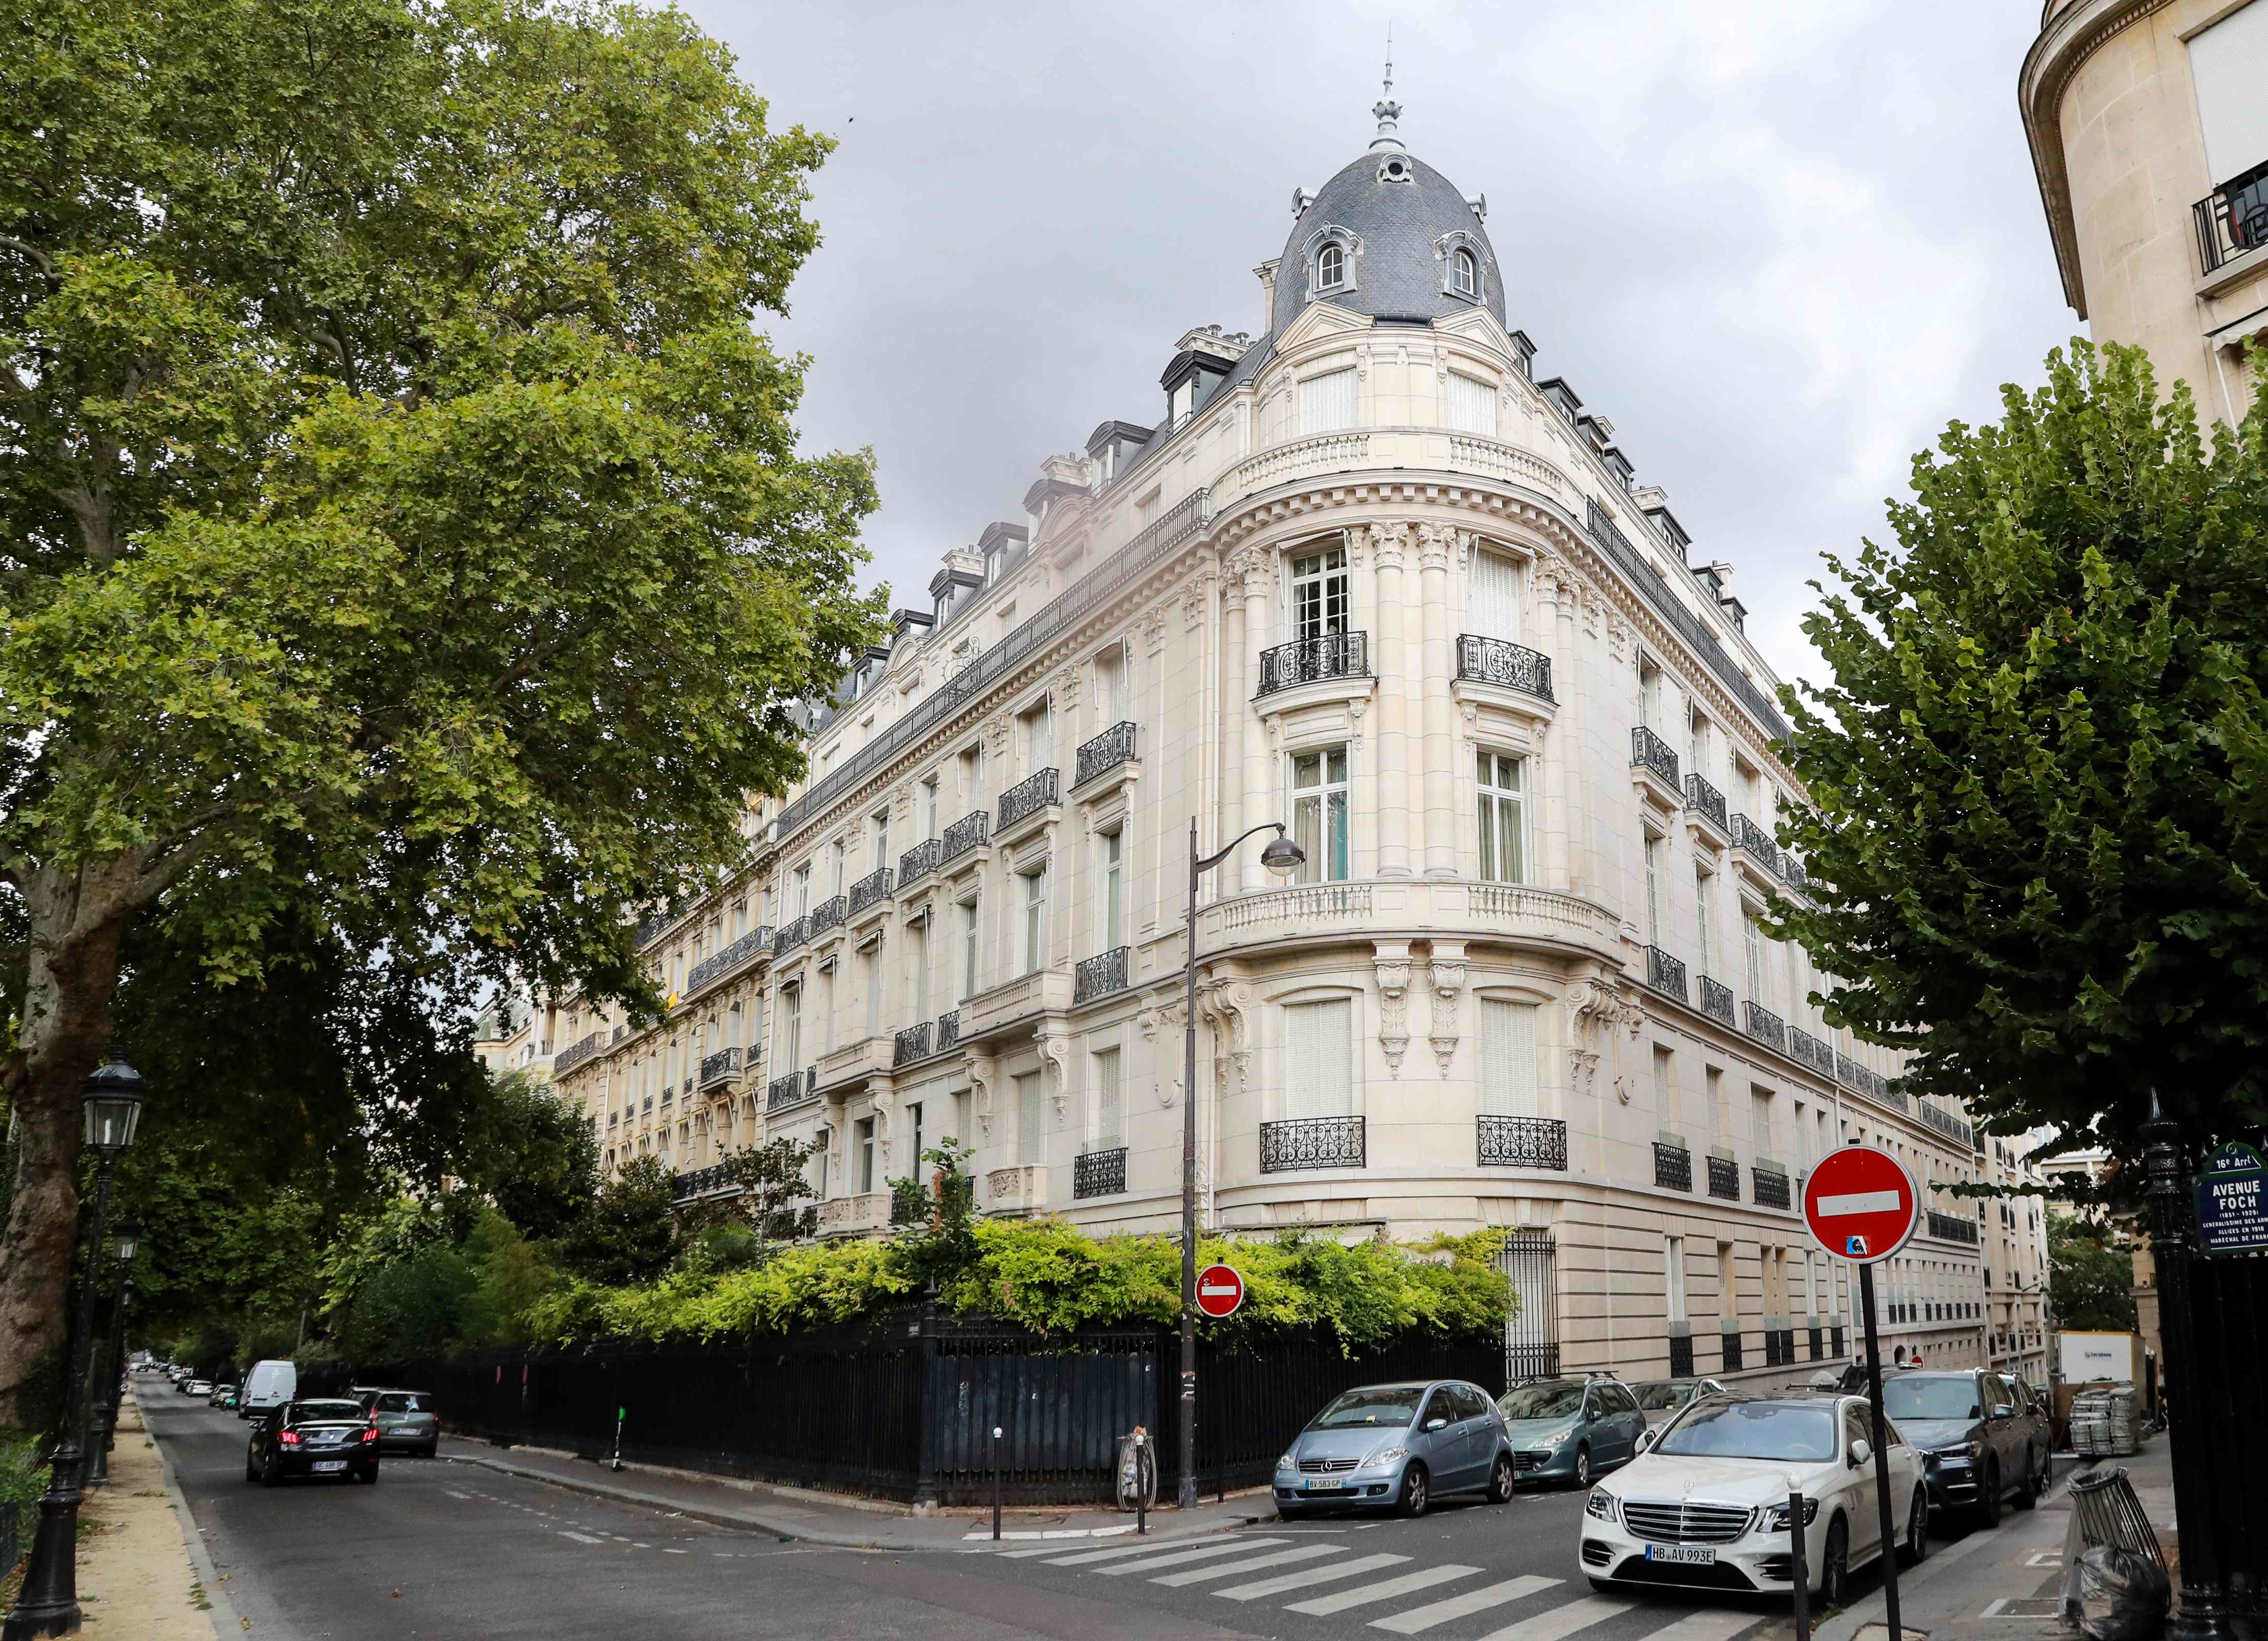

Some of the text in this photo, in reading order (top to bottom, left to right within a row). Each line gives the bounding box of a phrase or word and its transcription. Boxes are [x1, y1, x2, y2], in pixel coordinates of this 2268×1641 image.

[2212, 1180, 2261, 1197] AVENUE
[2219, 1195, 2256, 1210] FOCH
[1653, 1547, 1712, 1563] HB AV 993E
